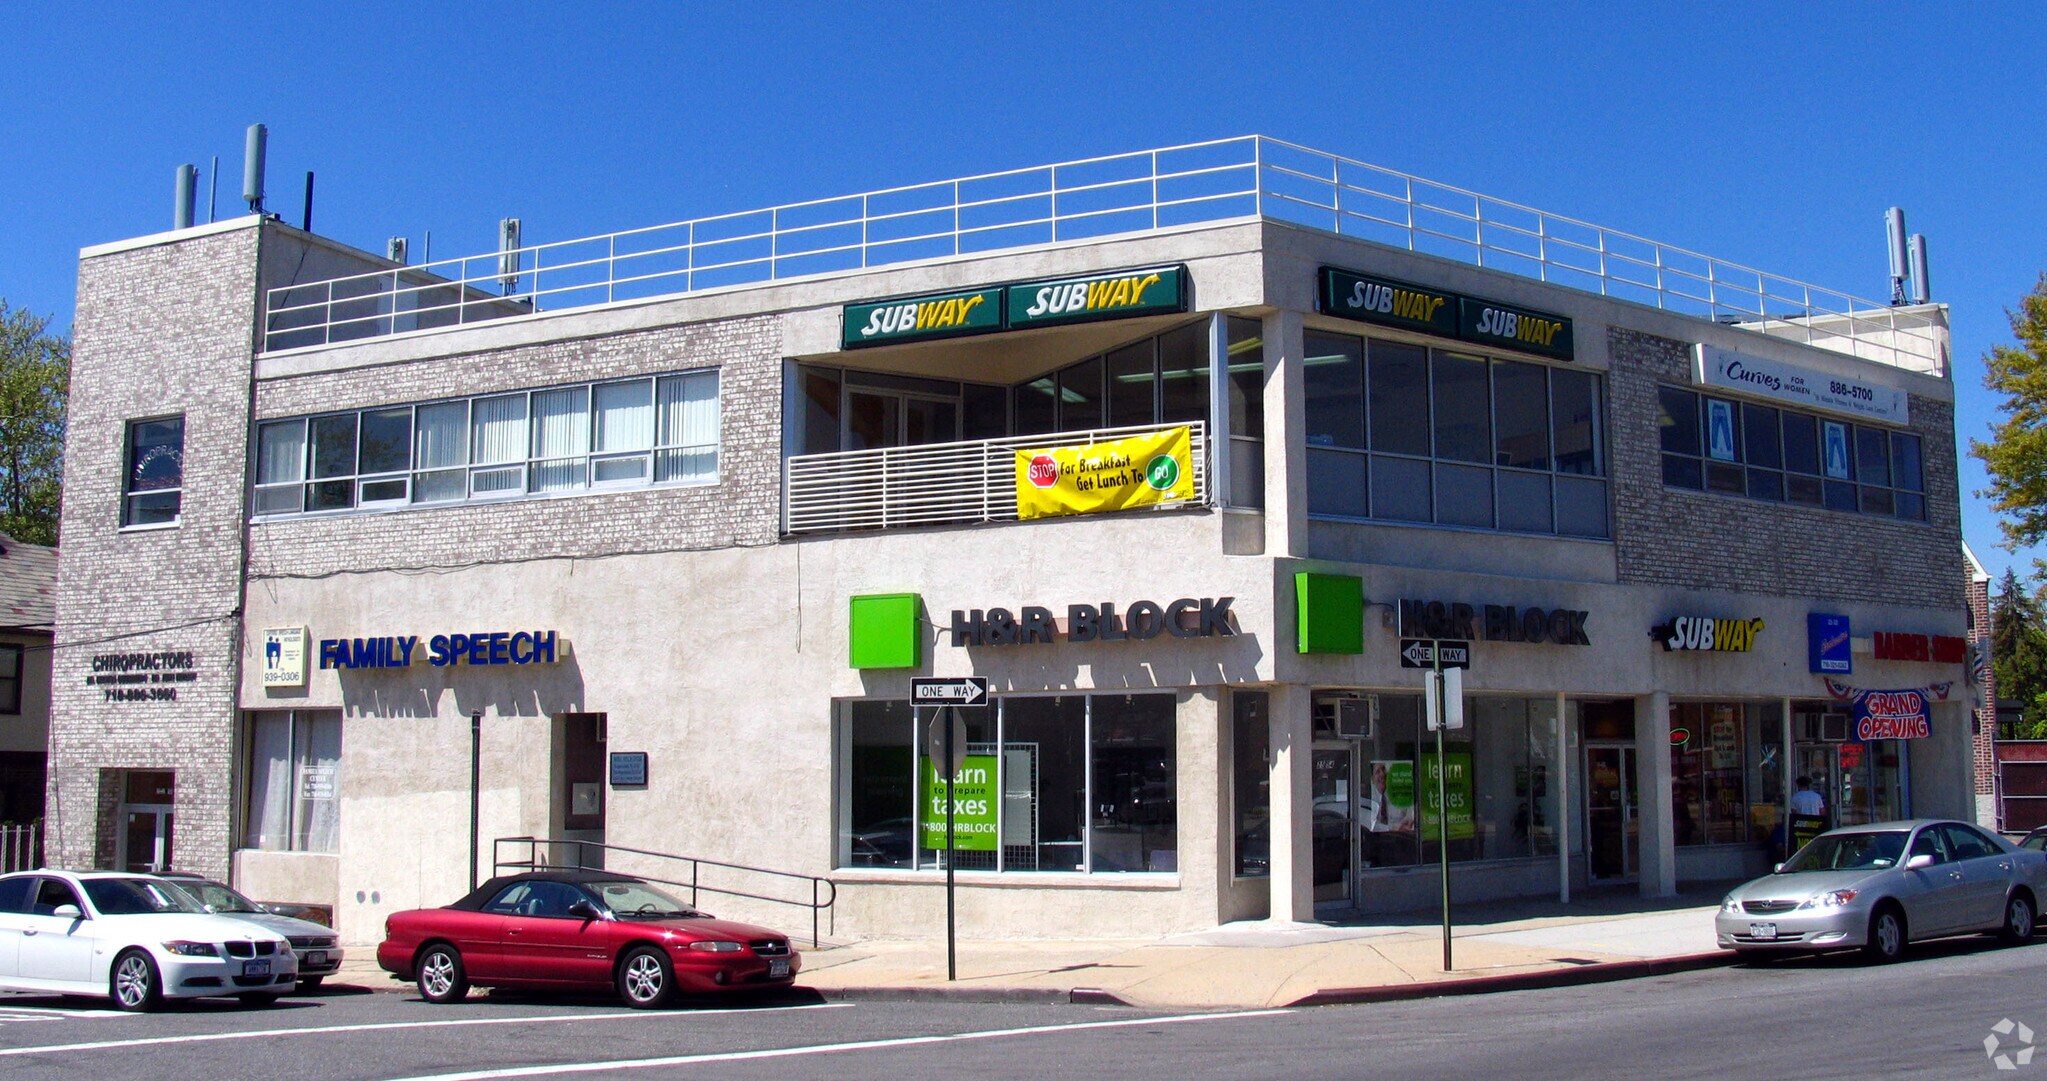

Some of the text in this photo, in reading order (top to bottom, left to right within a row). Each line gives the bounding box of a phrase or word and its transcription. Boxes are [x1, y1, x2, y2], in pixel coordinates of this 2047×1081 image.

[1026, 273, 1160, 318] SUBWAY
[1347, 281, 1445, 321] SUBWAY
[861, 294, 984, 337] SUBWAY
[1477, 308, 1562, 345] SUBWAY
[1726, 361, 1781, 390] Curves
[1791, 376, 1804, 386] FOR
[1784, 384, 1810, 395] WOMEN
[1830, 381, 1873, 401] 886-5700
[1030, 463, 1055, 478] STOP
[1079, 454, 1131, 473] Breakfast
[1076, 466, 1169, 491] Get Lunch To GO
[951, 597, 1237, 647] H&R BLOCK
[1398, 599, 1591, 646] H&R BLOCK
[1668, 616, 1765, 652] SUBWAY
[92, 651, 193, 672] CHIROPRACTORS
[320, 630, 556, 669] FAMILY SPEECH
[1410, 648, 1462, 660] ONE WAY
[264, 672, 300, 681] 939-0306
[922, 686, 976, 697] ONE WAY
[1865, 691, 1921, 716] GRAND
[1858, 714, 1929, 741] OPENING
[954, 788, 986, 796] repare
